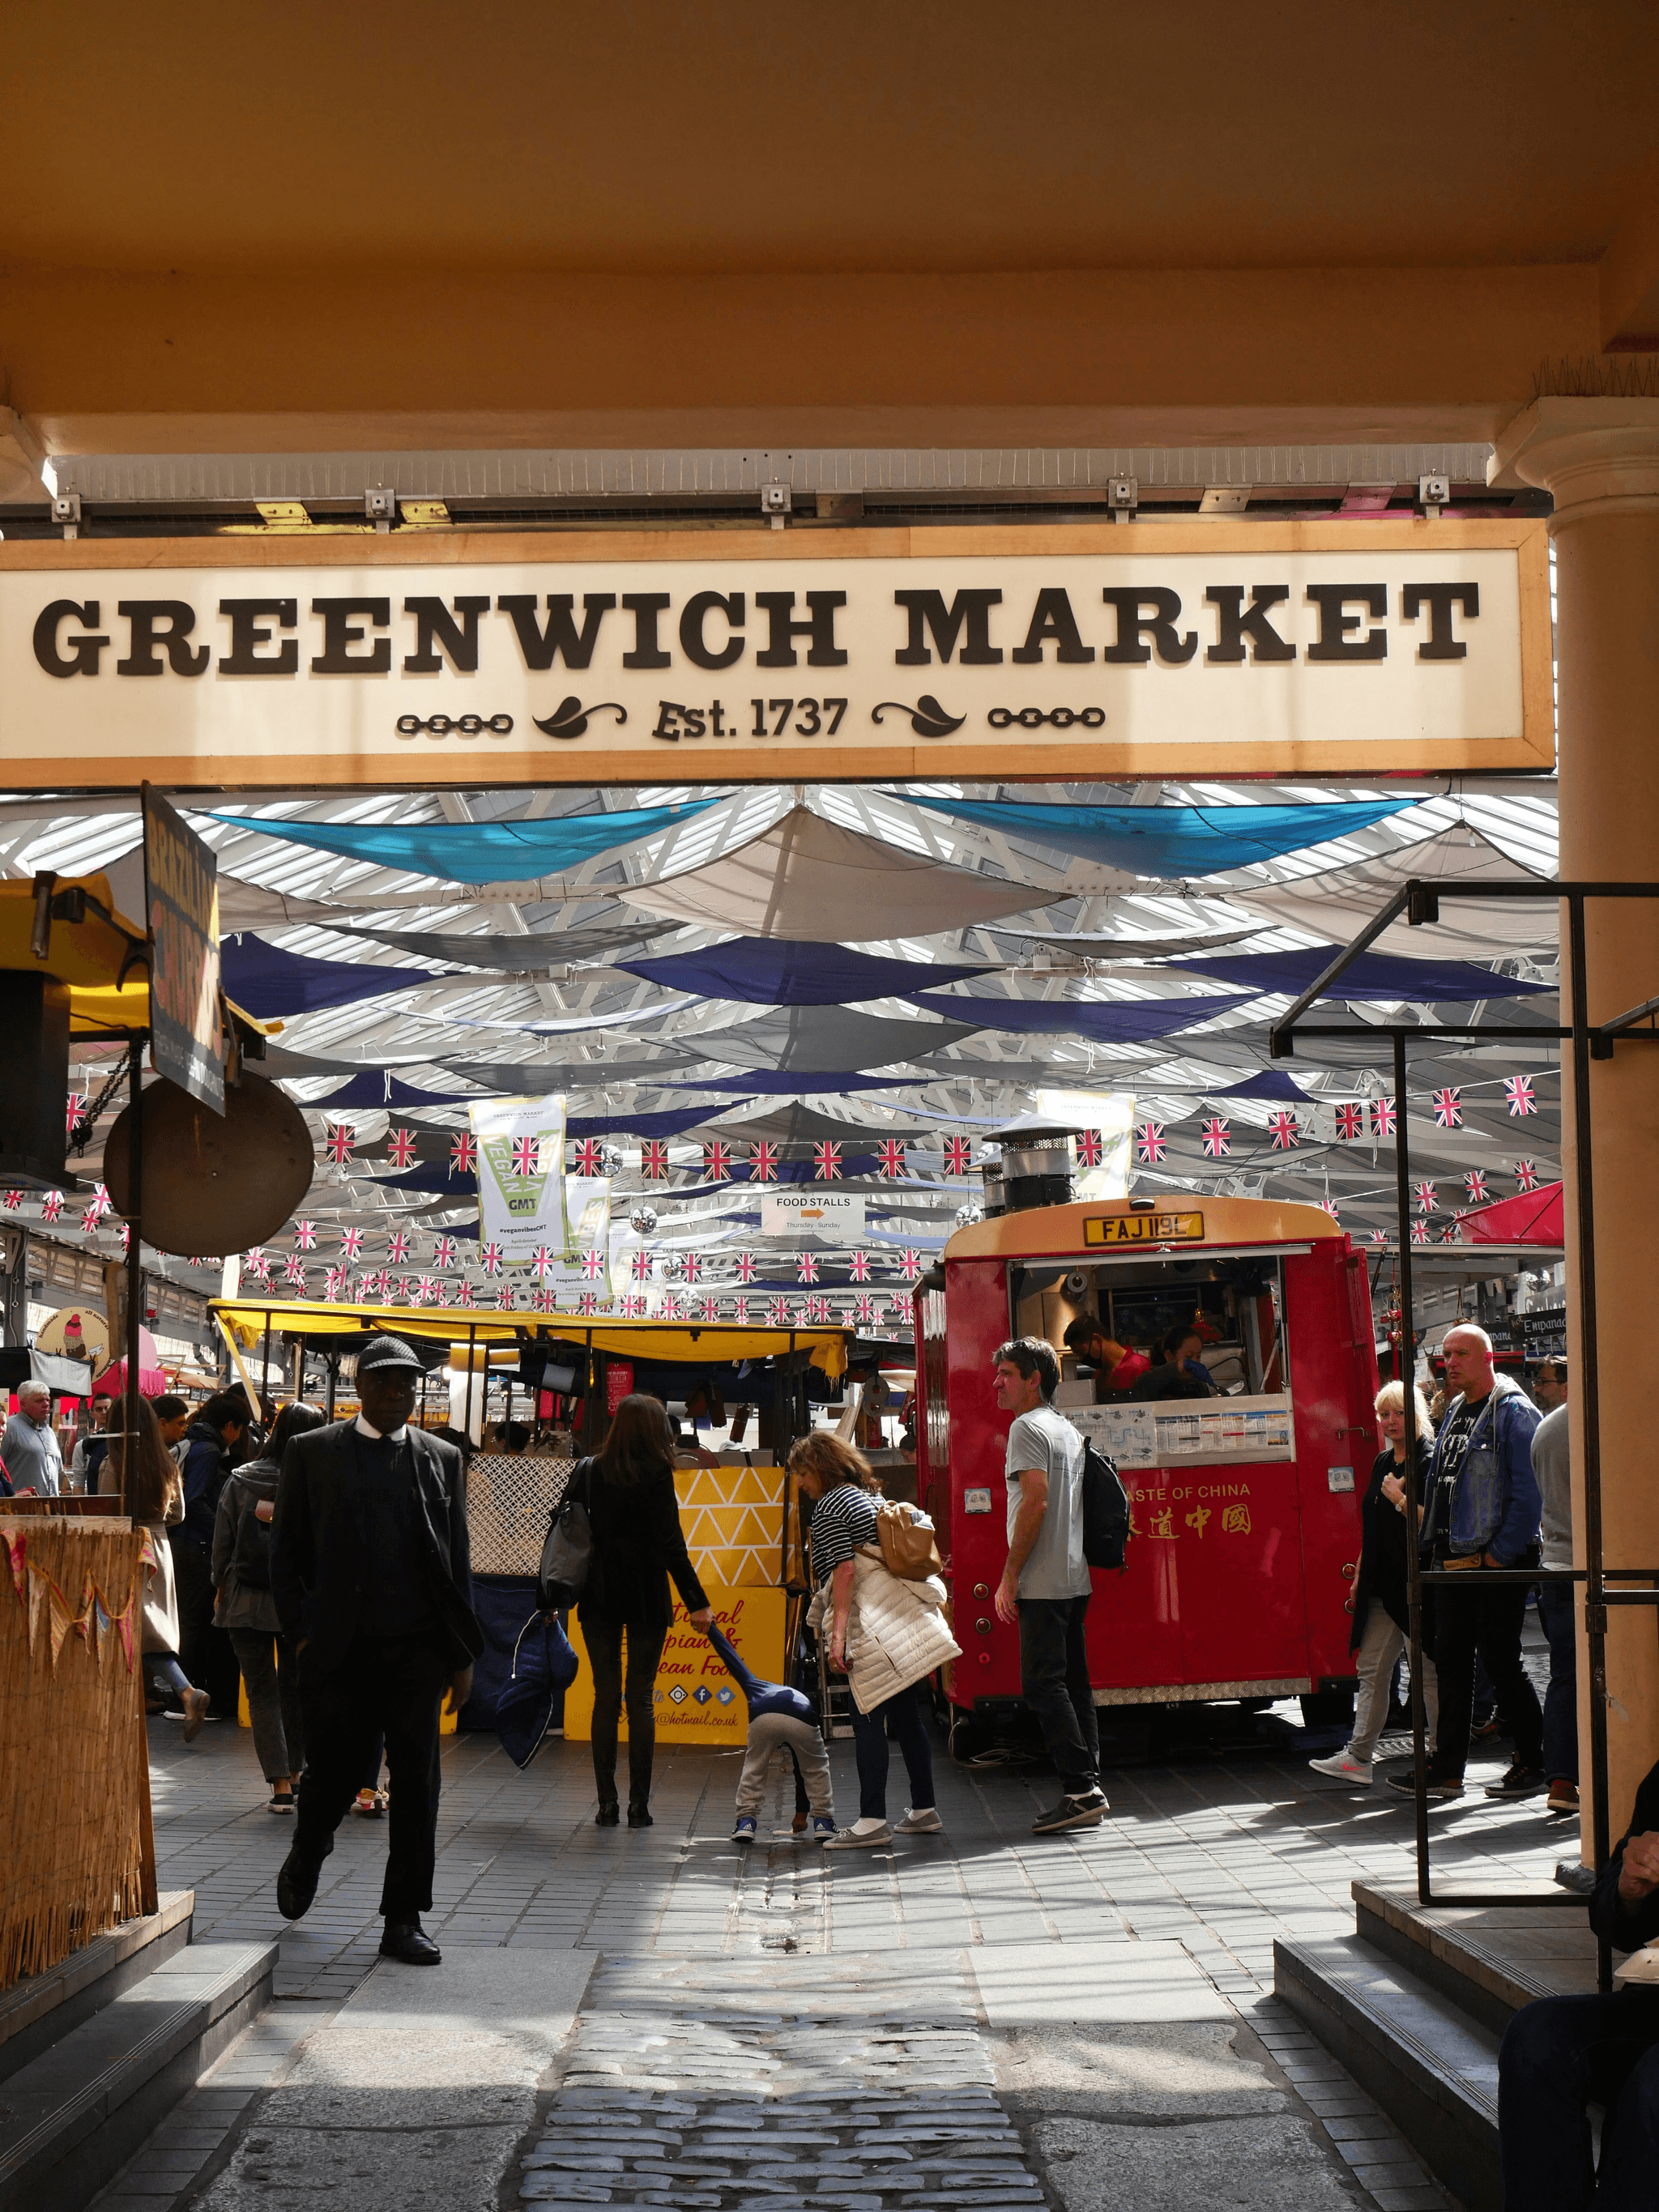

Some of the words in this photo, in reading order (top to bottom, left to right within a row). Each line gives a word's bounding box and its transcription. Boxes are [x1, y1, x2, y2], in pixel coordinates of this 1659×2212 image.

[32, 590, 847, 677] GREENWICH
[894, 582, 1480, 664] MARKET
[652, 700, 736, 741] Est.
[751, 697, 848, 736] 1737
[484, 1136, 522, 1193] VEGAN
[509, 1199, 536, 1211] GMT
[777, 1198, 808, 1206] FOOD
[809, 1198, 851, 1206] STALLS
[1078, 1193, 1097, 1202] MT
[500, 1225, 547, 1234] #veganvibesGMT
[1102, 1219, 1143, 1240] FAJ
[565, 1255, 583, 1264] GM
[39, 1315, 58, 1338] handmade
[1512, 1315, 1524, 1328] hot
[1126, 1488, 1166, 1502] ASTE
[1172, 1487, 1193, 1499] OF
[1198, 1484, 1250, 1498] CHINA
[663, 1634, 711, 1656] pian
[658, 1661, 695, 1674] ean
[701, 1656, 736, 1675] Foo
